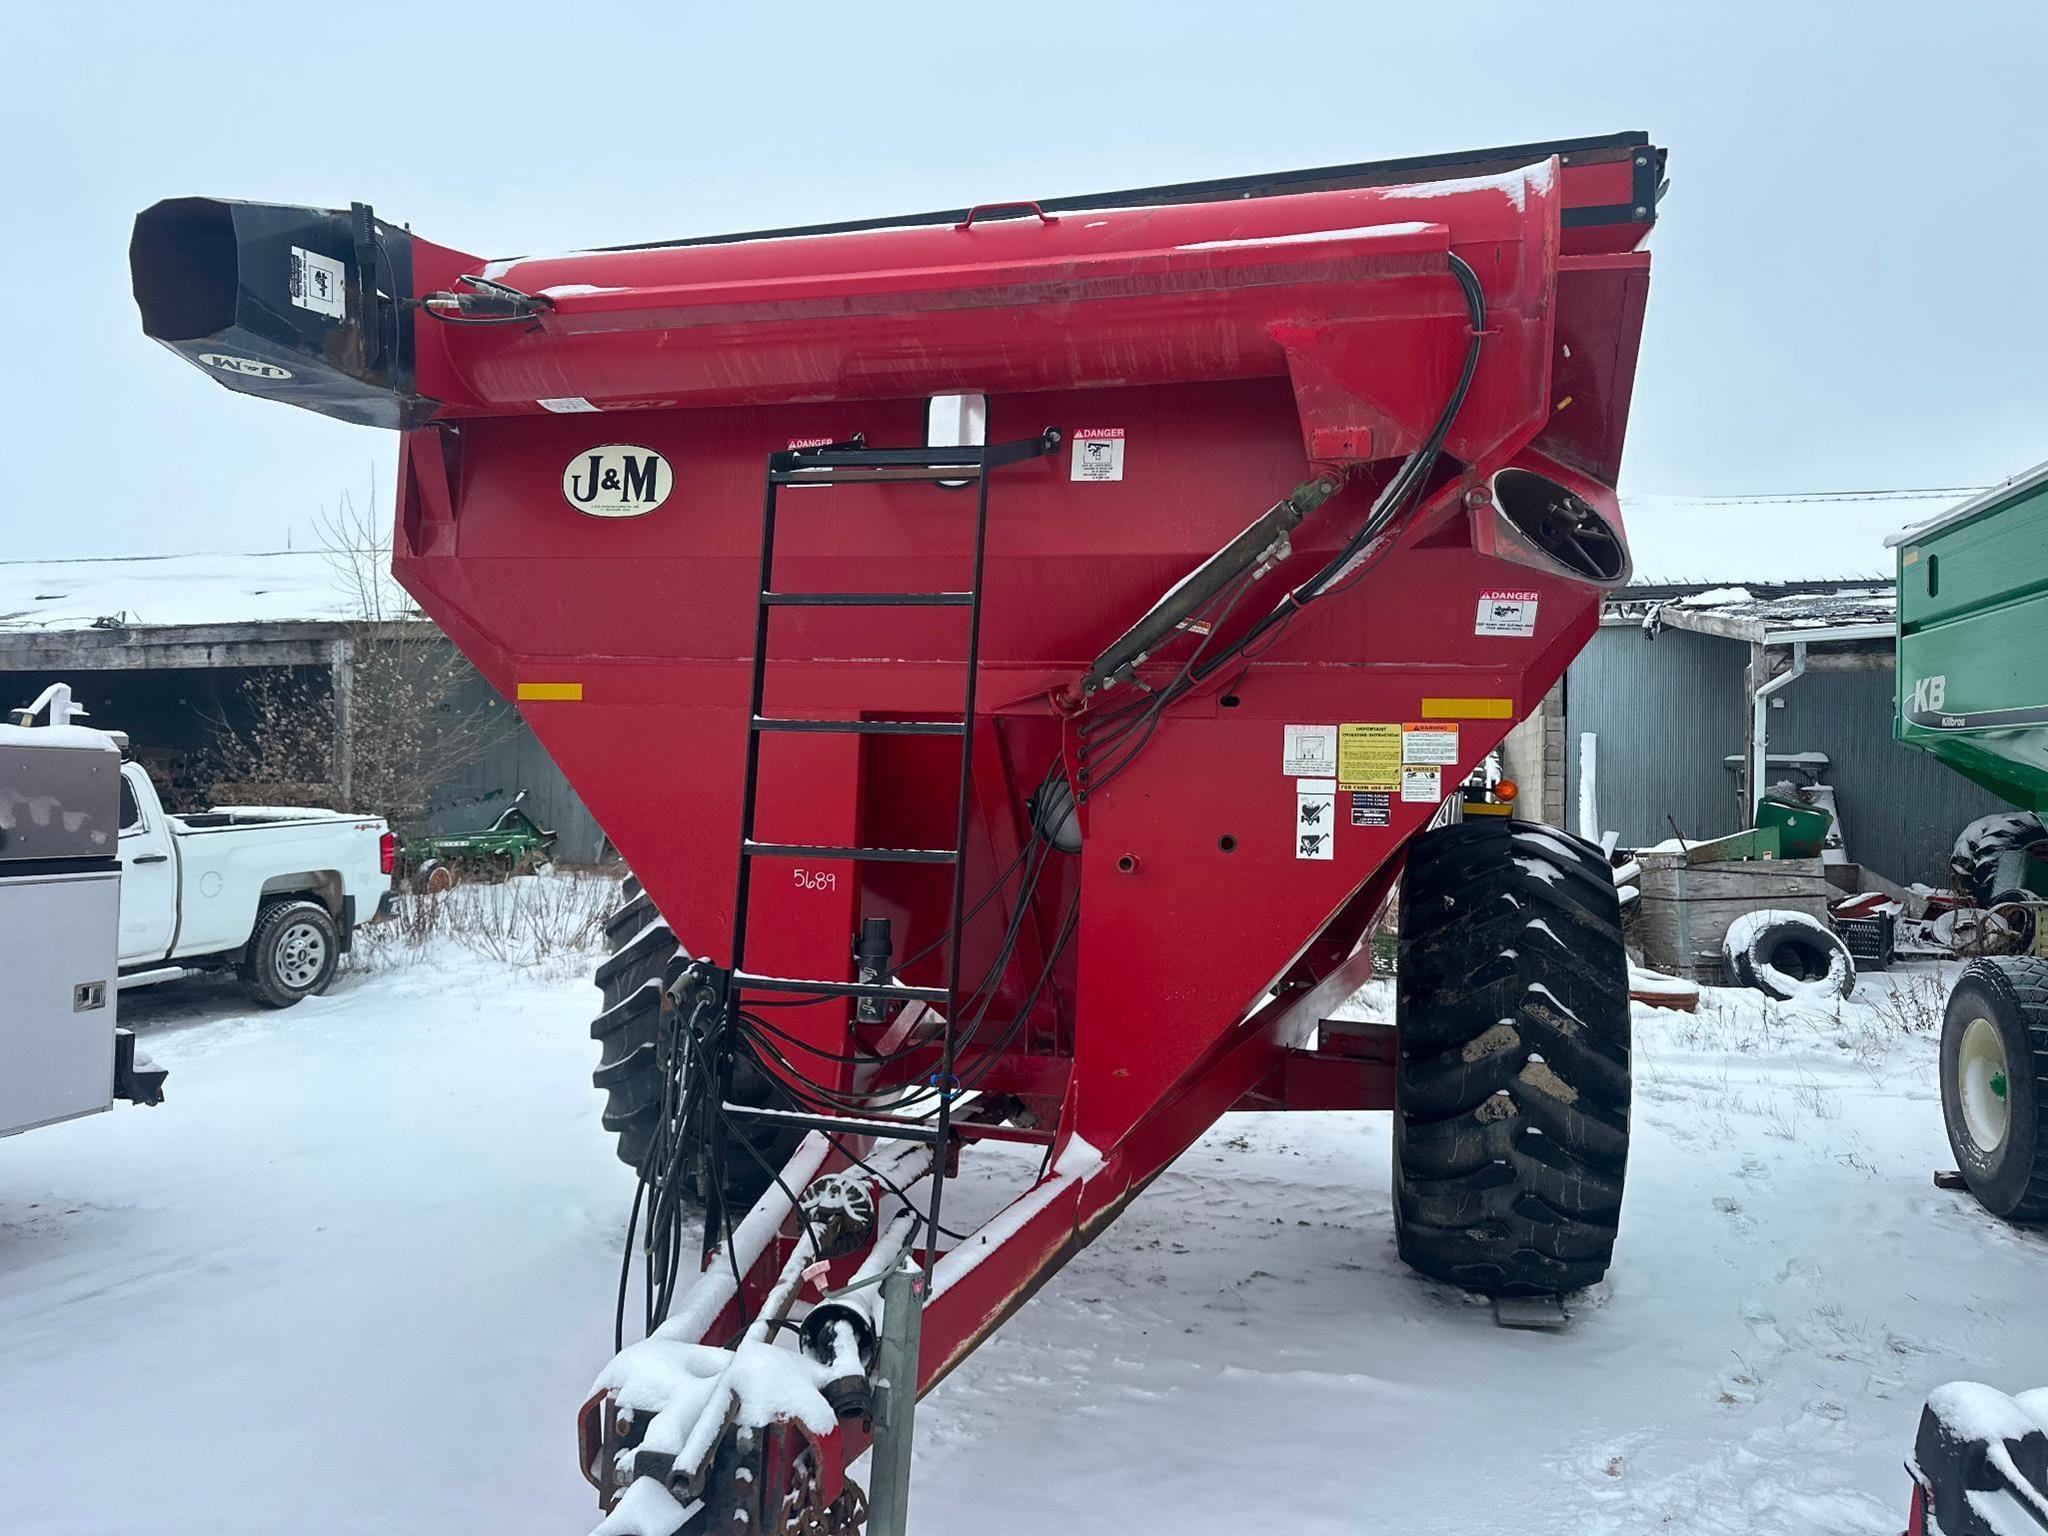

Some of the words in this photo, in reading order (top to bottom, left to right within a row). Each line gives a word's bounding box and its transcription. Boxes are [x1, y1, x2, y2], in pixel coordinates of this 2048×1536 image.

[1084, 428, 1125, 438] DANGER
[796, 438, 833, 448] DANGER
[571, 455, 660, 502] J&M
[1491, 591, 1539, 600] DANGER
[1913, 675, 1946, 713] KB
[1941, 717, 1966, 727] Kilbros
[794, 868, 836, 891] 5689
